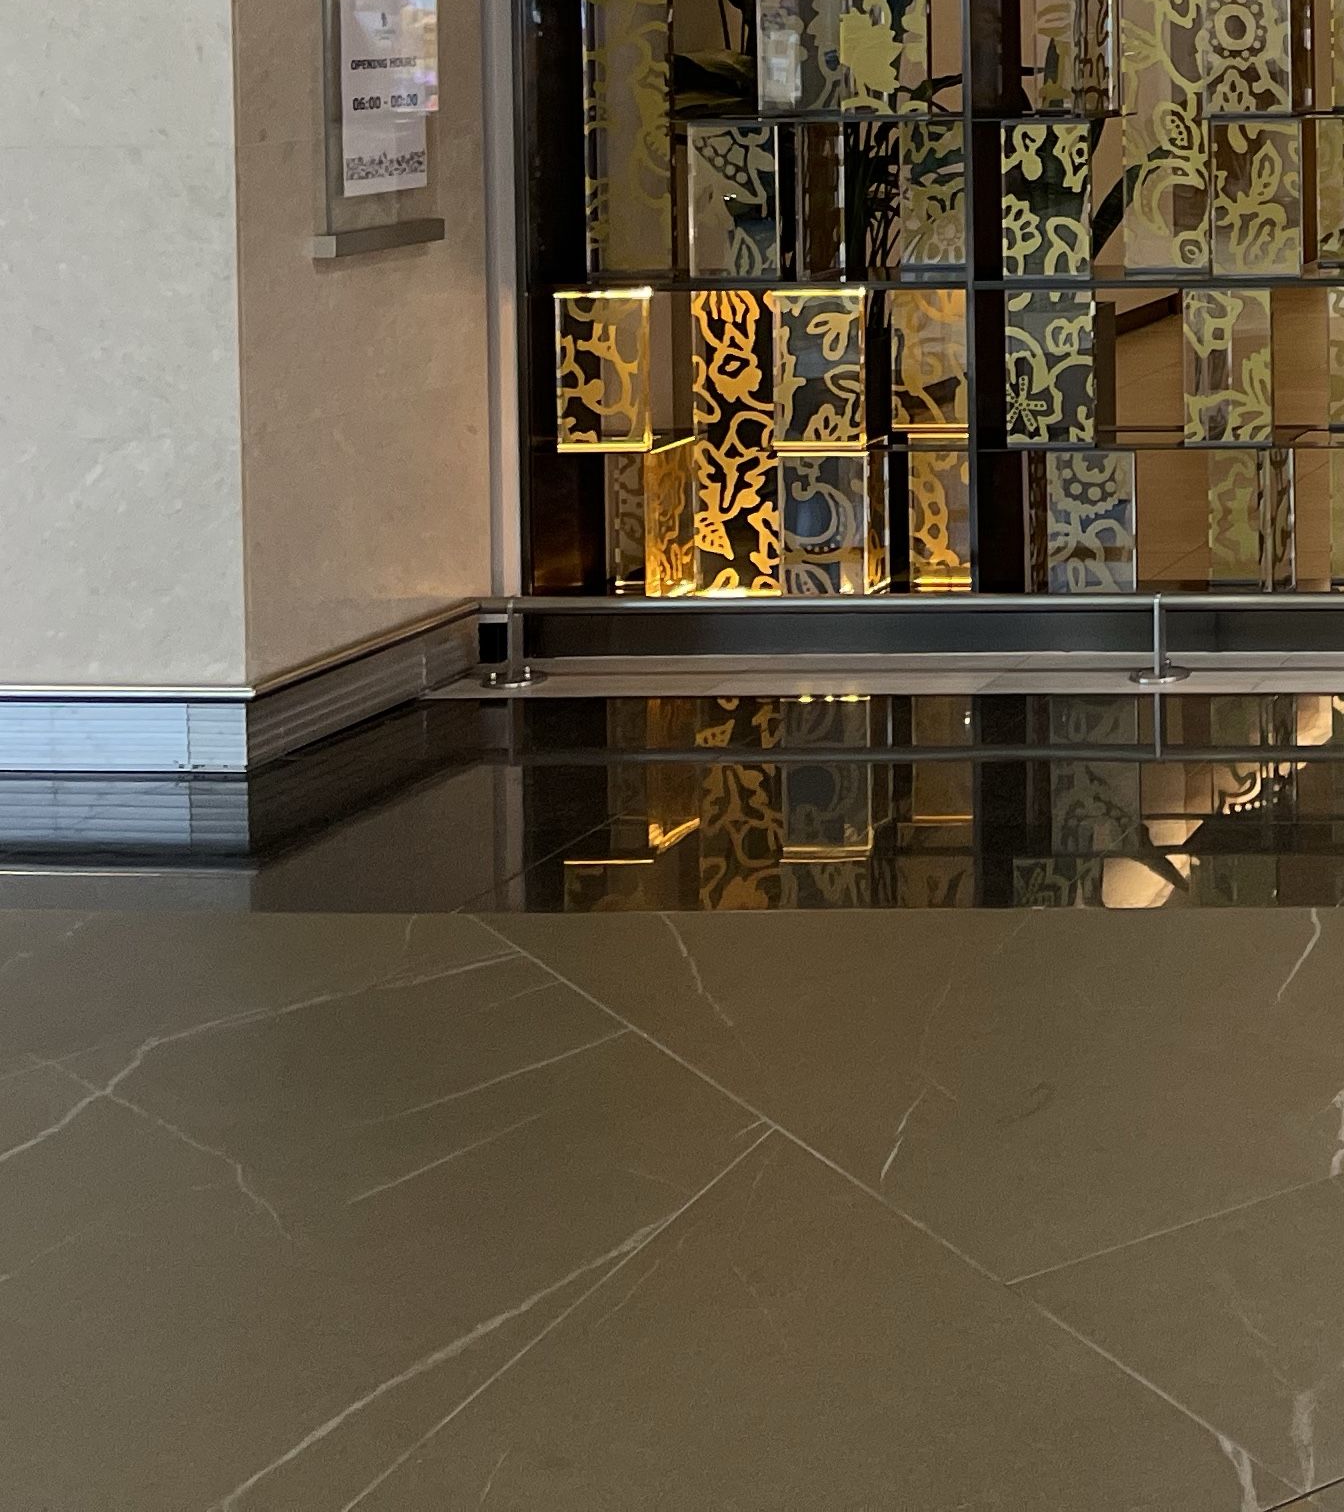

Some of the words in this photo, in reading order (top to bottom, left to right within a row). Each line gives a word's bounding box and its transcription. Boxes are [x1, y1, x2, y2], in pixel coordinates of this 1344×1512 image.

[351, 59, 388, 70] OPENING
[389, 57, 417, 68] HOURS
[353, 96, 381, 111] 06:00
